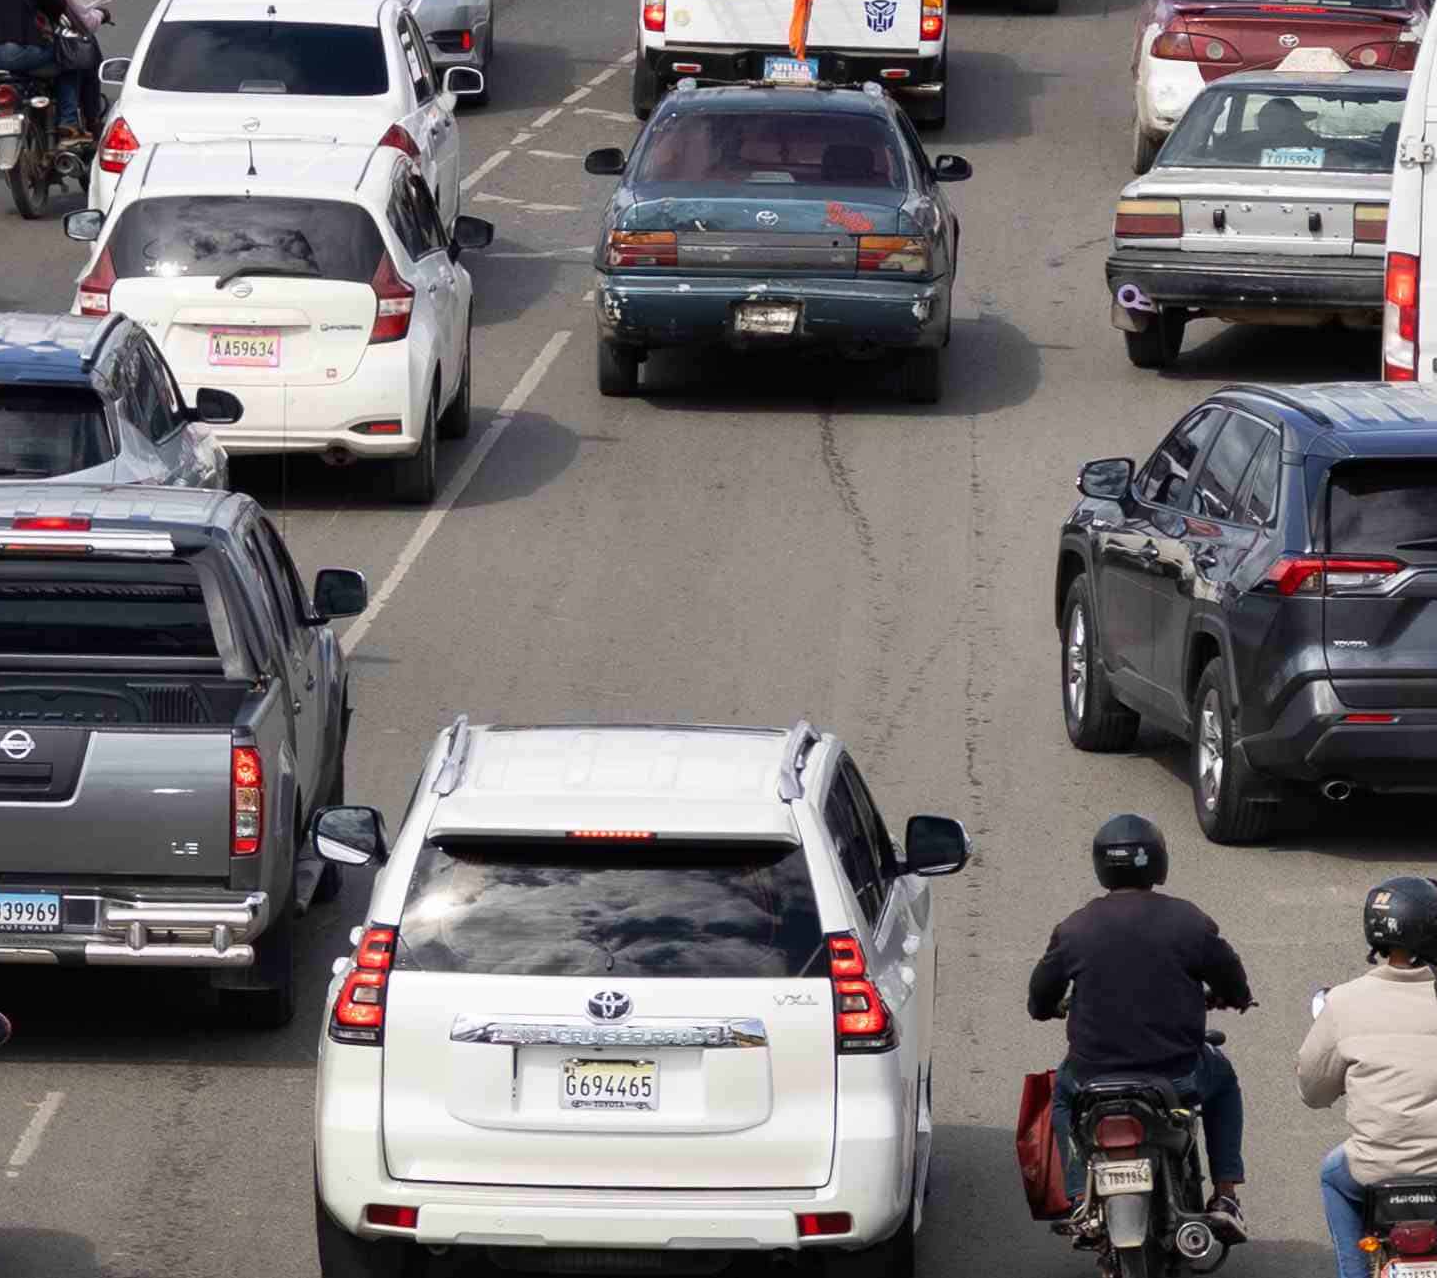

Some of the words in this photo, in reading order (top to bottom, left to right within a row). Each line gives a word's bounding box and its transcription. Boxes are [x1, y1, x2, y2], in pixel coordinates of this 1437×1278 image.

[214, 334, 275, 357] AA59634
[170, 842, 199, 855] LE
[566, 1075, 653, 1097] G694465
